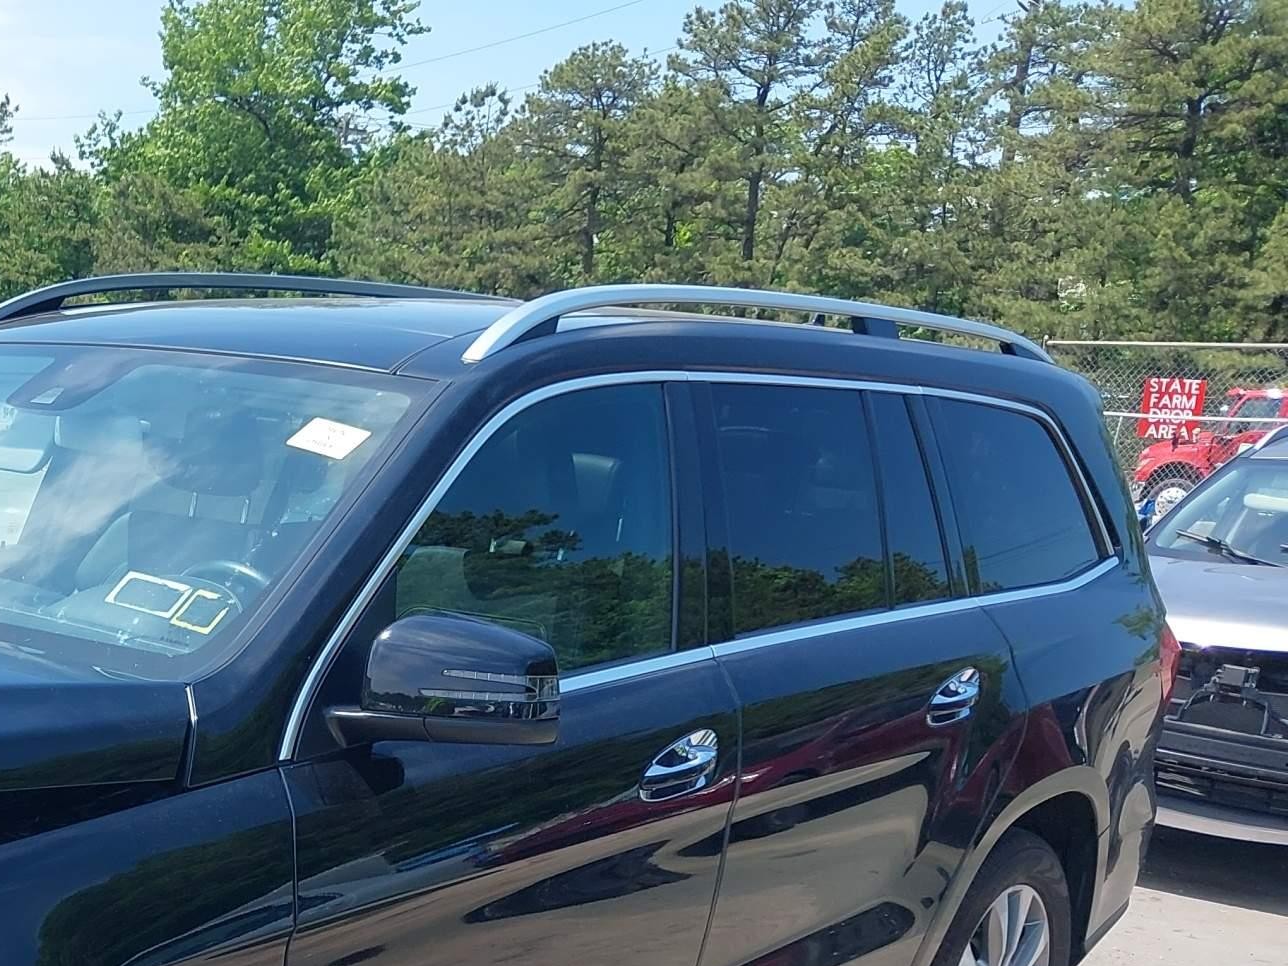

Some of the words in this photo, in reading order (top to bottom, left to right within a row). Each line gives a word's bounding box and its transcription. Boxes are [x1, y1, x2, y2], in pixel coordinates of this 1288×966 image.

[1150, 378, 1201, 394] STATE
[1149, 393, 1197, 410] FARM
[1148, 408, 1192, 424] DROP
[1144, 424, 1189, 440] AREA
